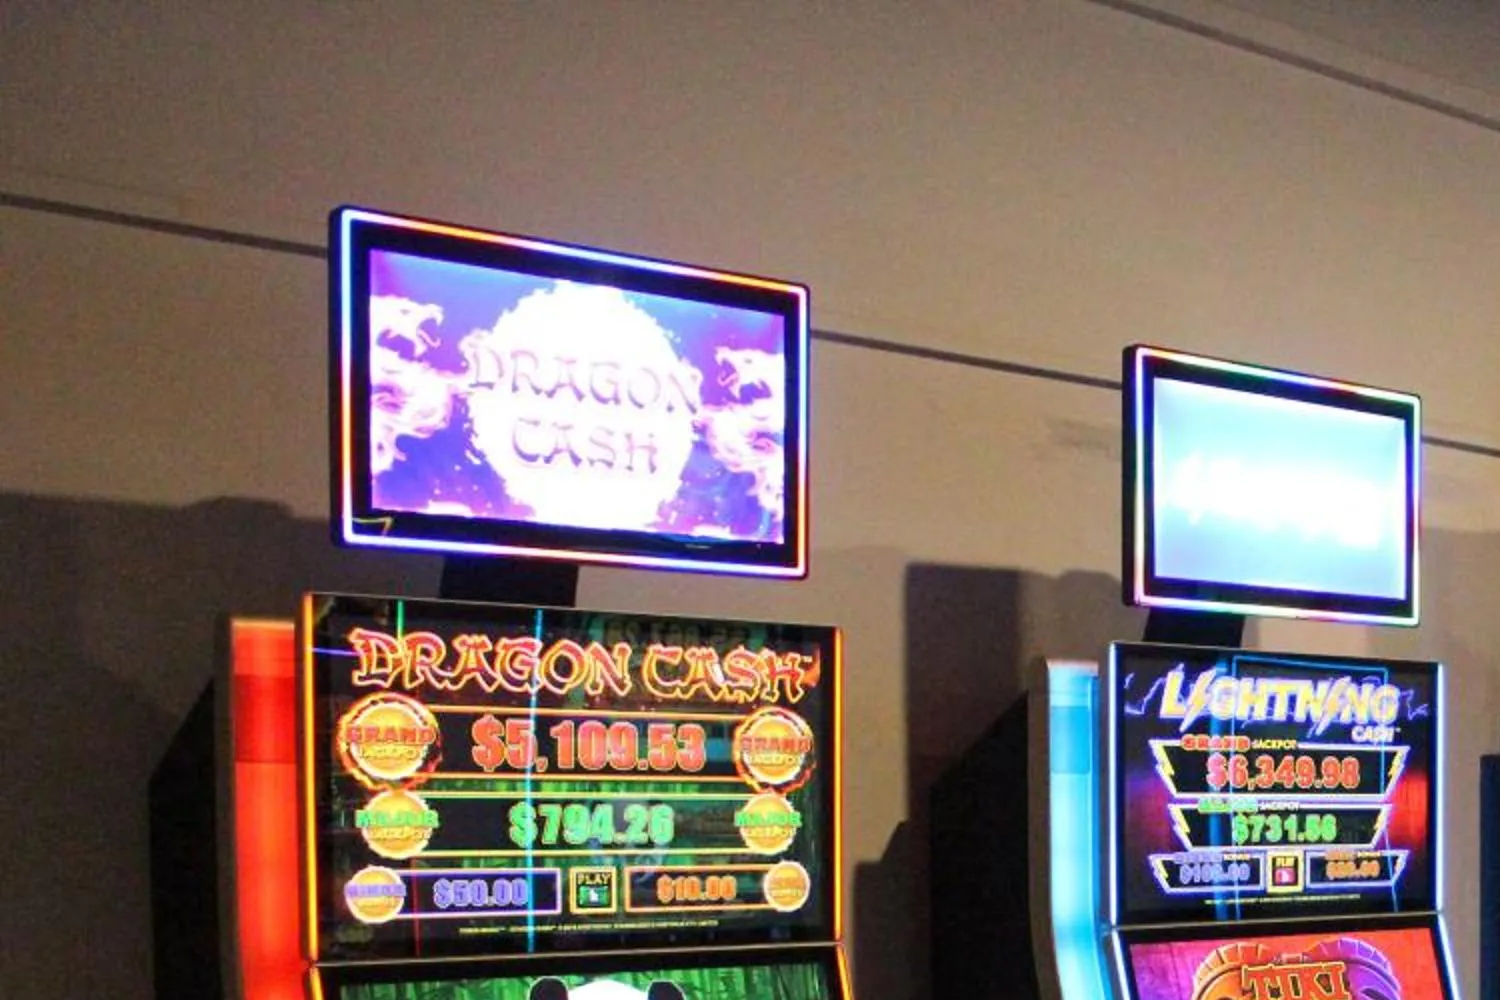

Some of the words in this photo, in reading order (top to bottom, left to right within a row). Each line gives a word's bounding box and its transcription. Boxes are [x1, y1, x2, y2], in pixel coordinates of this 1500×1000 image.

[468, 346, 704, 417] DRAGON
[512, 416, 661, 475] CASH
[347, 627, 634, 696] DRAGON
[641, 643, 810, 703] CASH
[1160, 666, 1400, 736] LIGHTNING
[472, 714, 707, 772] $5,109.53
[1352, 725, 1394, 743] CASH
[508, 802, 676, 848] $794.26
[433, 878, 530, 908] $50.00
[577, 872, 612, 885] PLAY
[656, 875, 737, 904] $10.00
